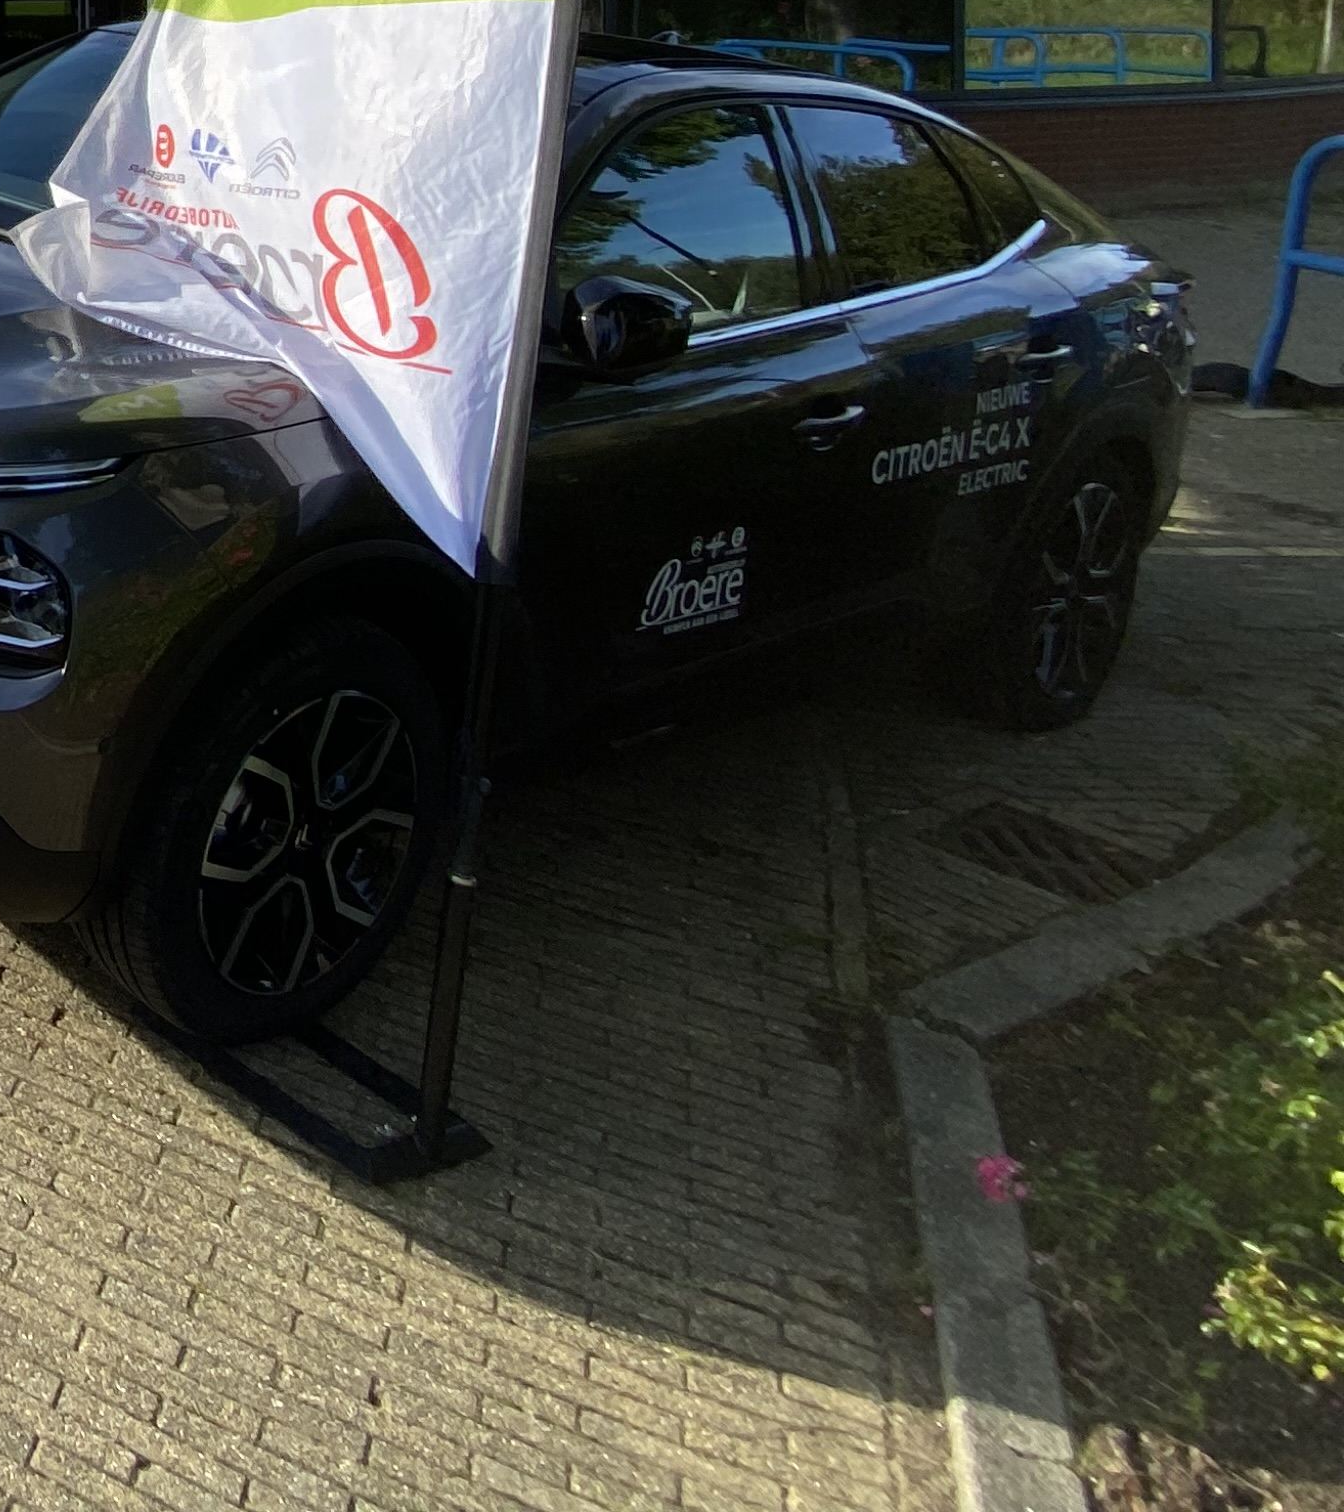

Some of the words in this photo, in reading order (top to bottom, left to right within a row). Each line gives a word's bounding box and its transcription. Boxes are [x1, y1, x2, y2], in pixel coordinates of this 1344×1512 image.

[976, 382, 1031, 415] NIEUWE
[872, 426, 965, 485] CITROËN
[1014, 416, 1031, 448] X
[957, 460, 1030, 496] ELECTRIC
[640, 558, 745, 626] Broere
